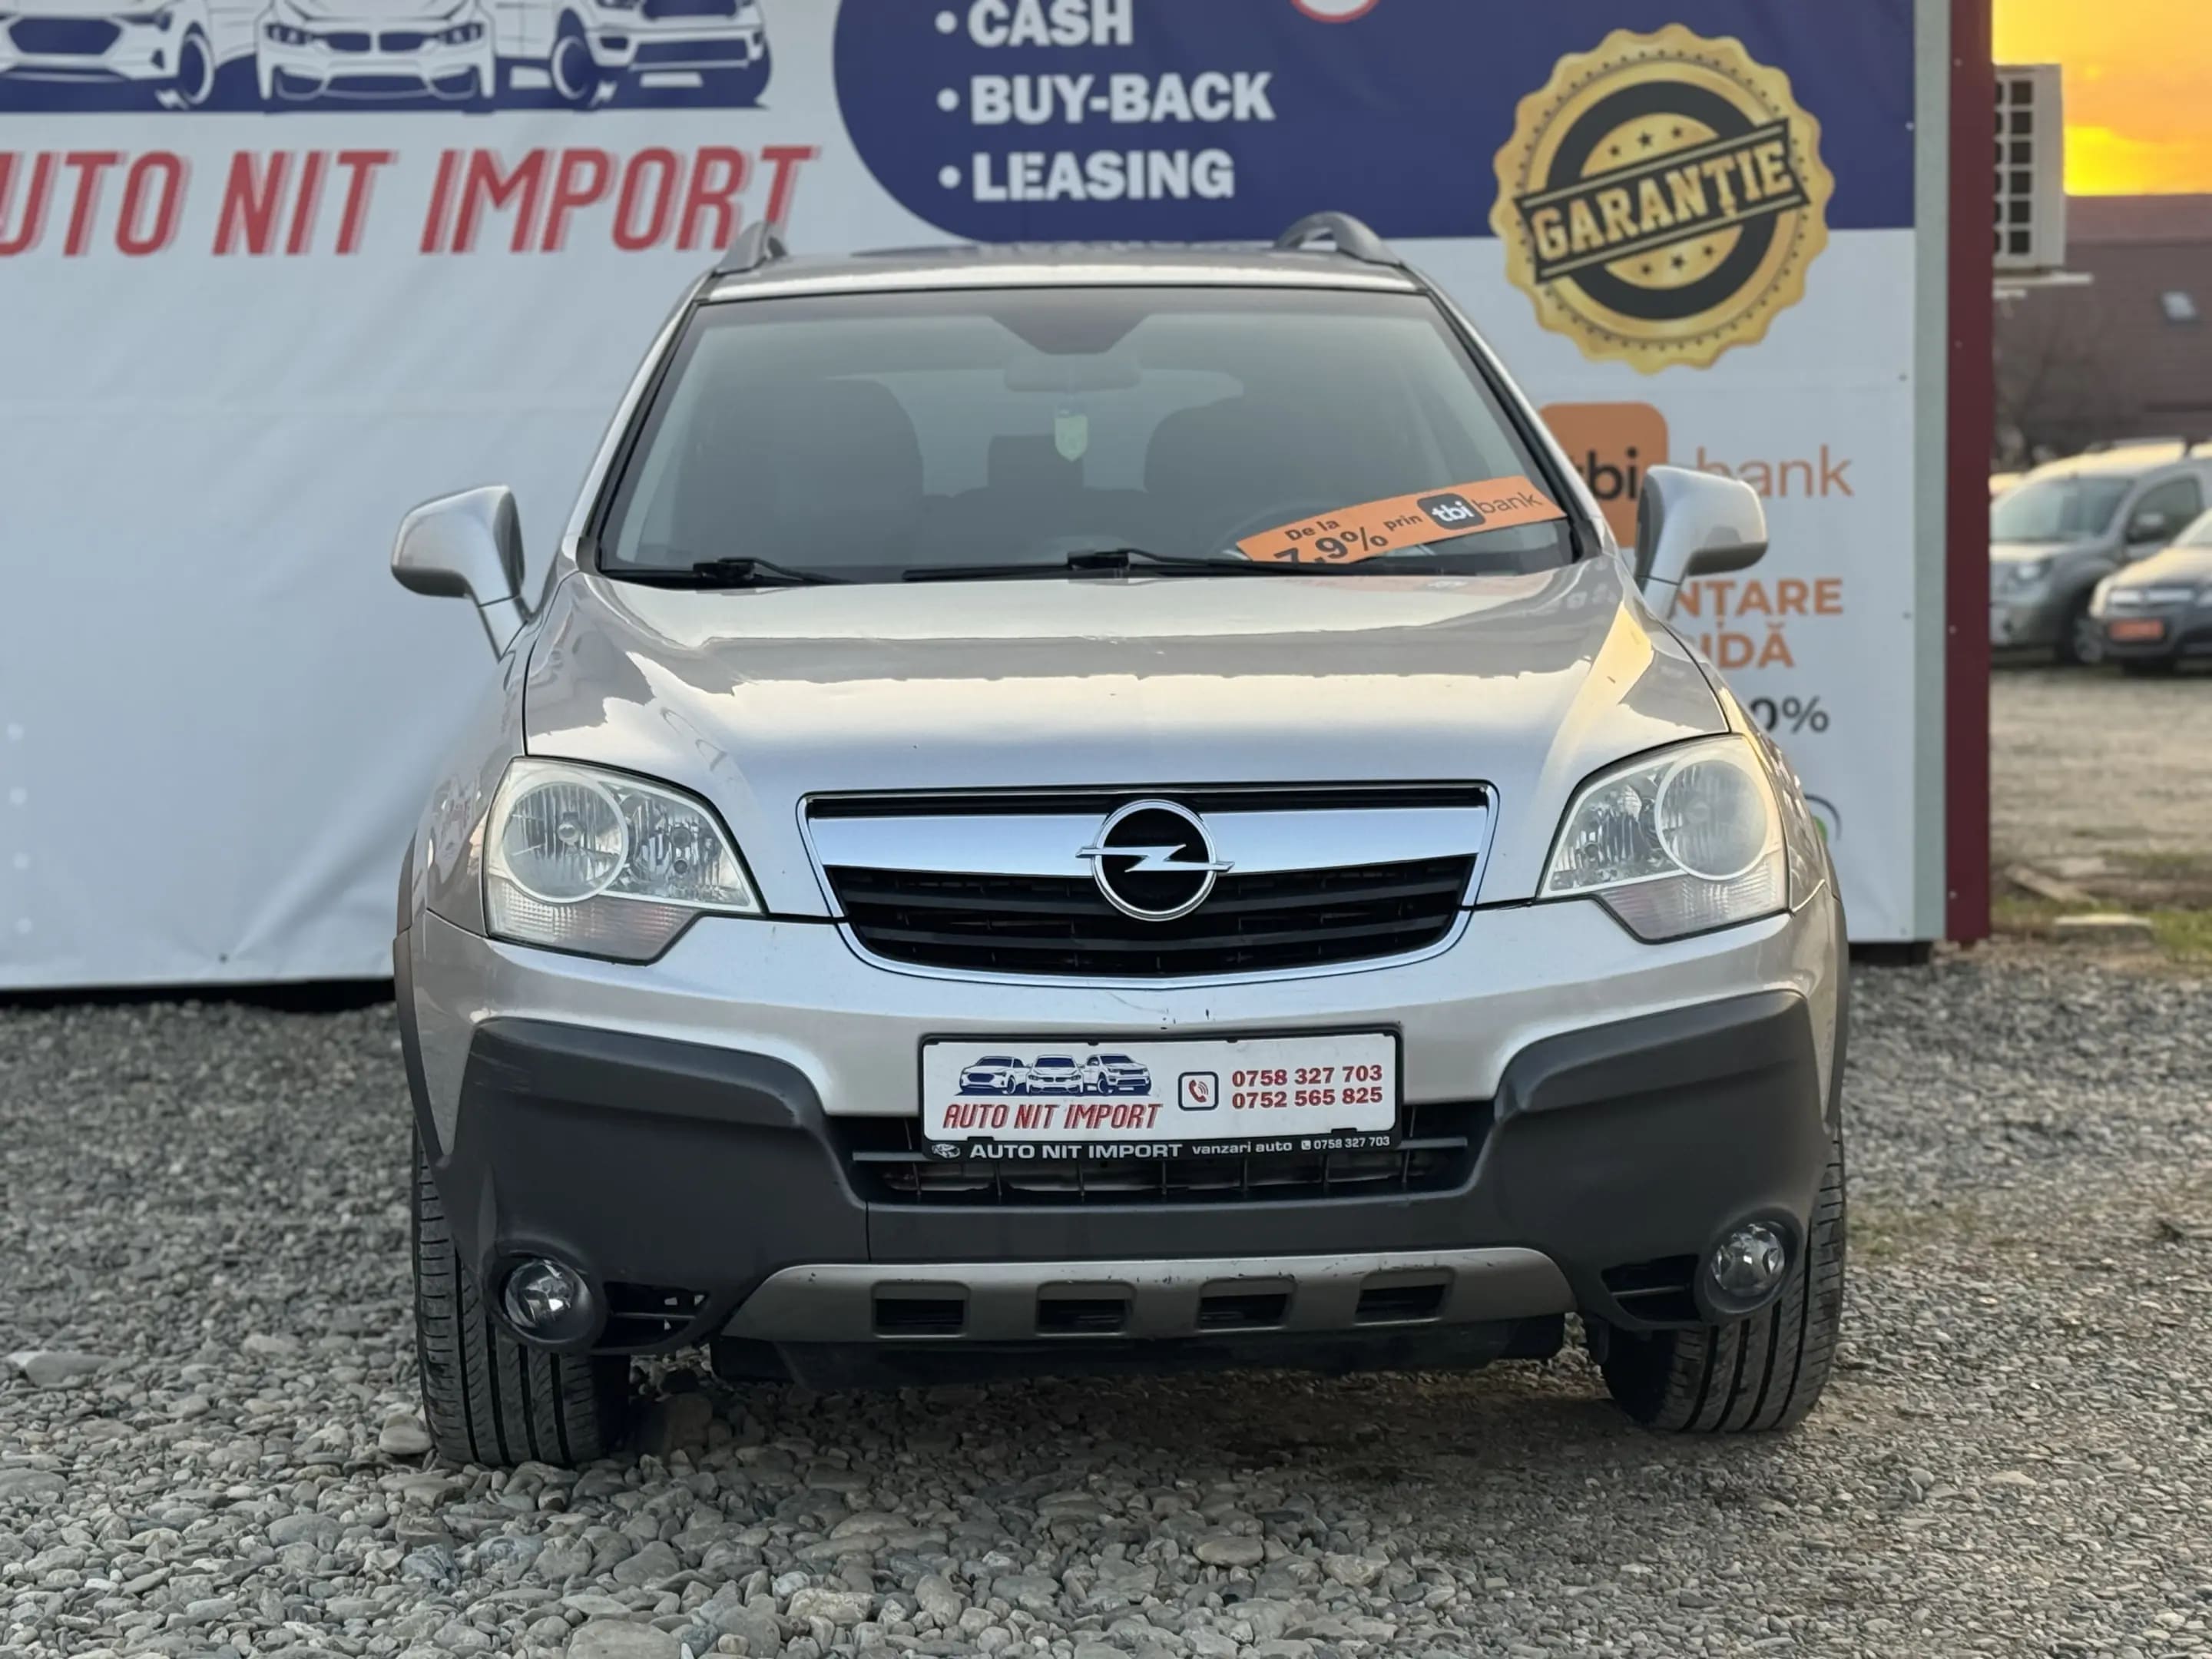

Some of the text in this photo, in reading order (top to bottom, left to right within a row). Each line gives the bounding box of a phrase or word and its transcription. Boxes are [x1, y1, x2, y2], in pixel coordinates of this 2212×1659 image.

[968, 0, 1133, 46] CASH
[971, 72, 1274, 124] BUY-BACK
[973, 149, 1234, 201] LEASING
[212, 149, 398, 257] NIT
[419, 145, 822, 255] IMPORT
[1573, 446, 1638, 501] bi
[1284, 520, 1340, 541] De la
[1383, 492, 1542, 531] prin tbi bank
[1232, 1065, 1382, 1088] 0758 327 703
[942, 1103, 1164, 1129] AUTO NIT IMPORT
[1232, 1087, 1383, 1109] 0752 565 825
[969, 1136, 1390, 1158] AUTO NIT IMPORT vanzari auto 0758 327 703
